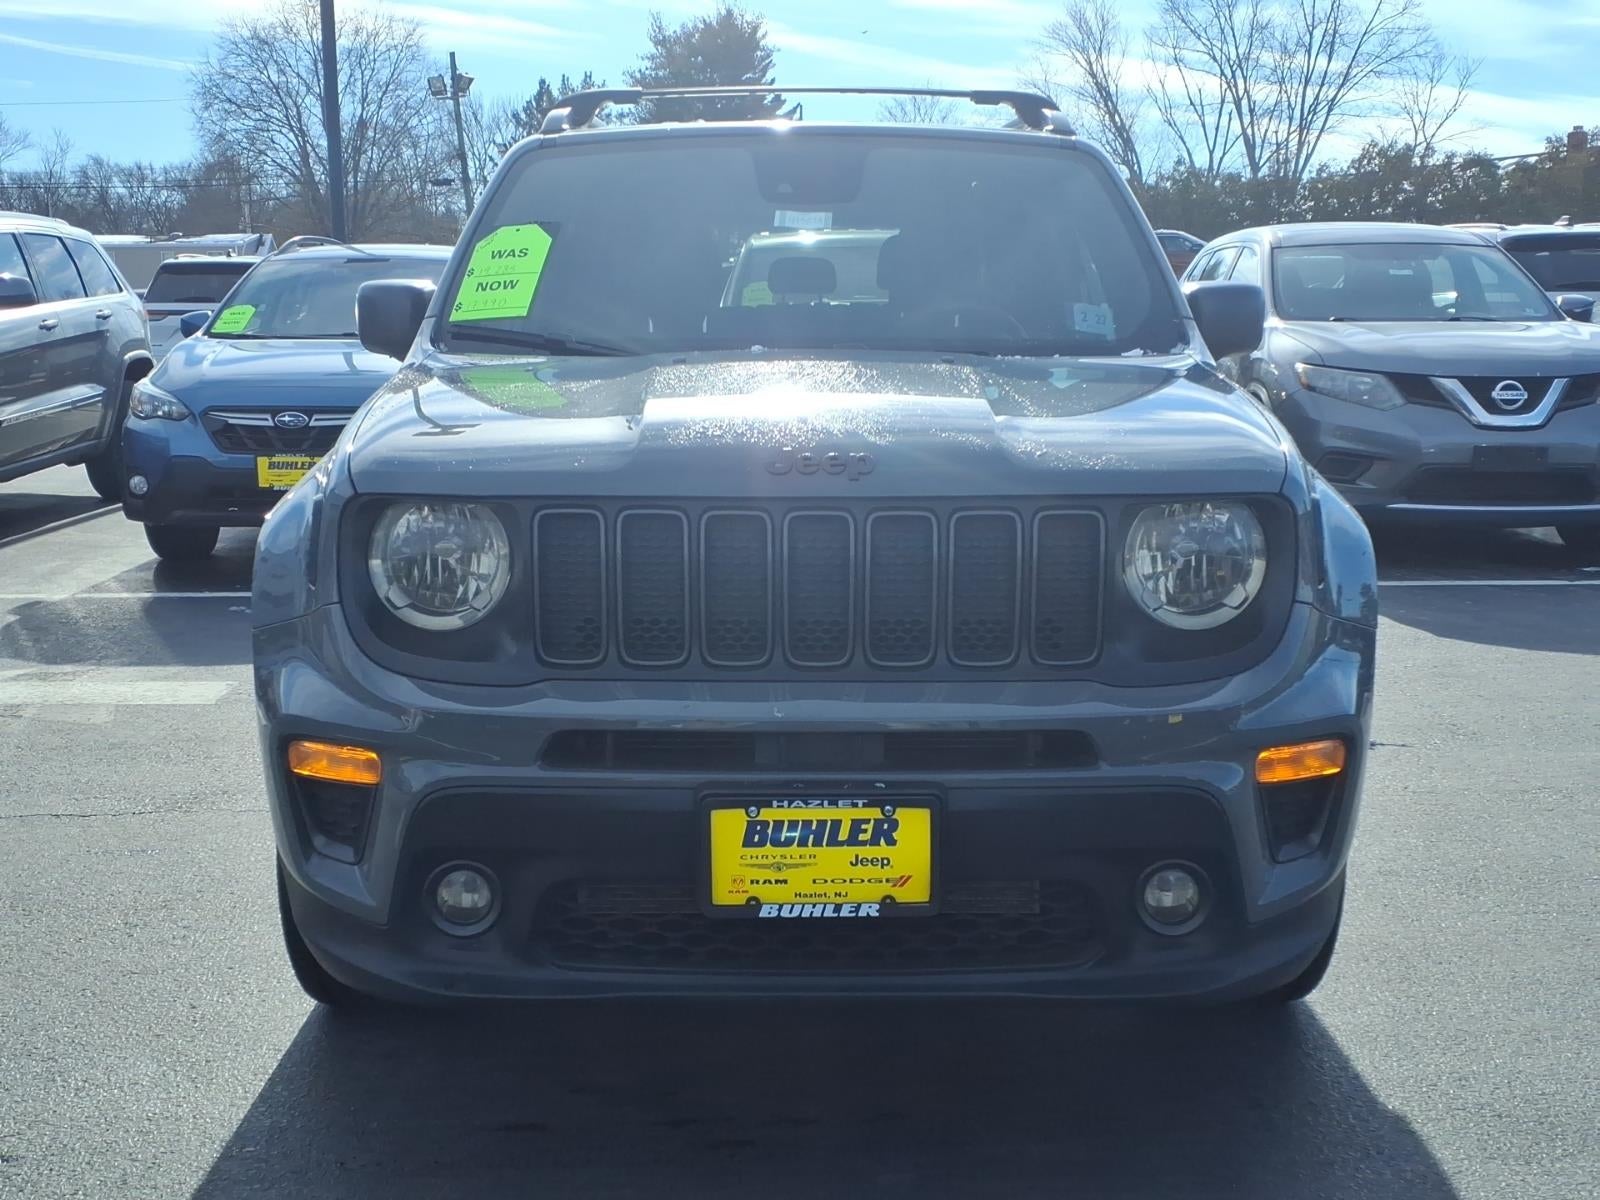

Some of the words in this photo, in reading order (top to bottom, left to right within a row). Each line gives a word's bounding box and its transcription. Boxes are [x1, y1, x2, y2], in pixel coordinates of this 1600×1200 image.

[490, 247, 529, 260] WAS
[466, 267, 475, 278] $
[475, 279, 520, 293] NOW
[454, 302, 463, 312] $
[765, 447, 876, 482] Jeep
[772, 800, 868, 808] HAZLET
[742, 818, 900, 848] BUHLER
[740, 853, 817, 861] CHRYSLER
[849, 853, 892, 869] Jeep
[749, 878, 789, 886] RAM
[812, 877, 898, 885] DODGE
[794, 891, 831, 900] Hazlet,
[834, 890, 849, 899] NJ
[758, 903, 880, 918] BUHLER
